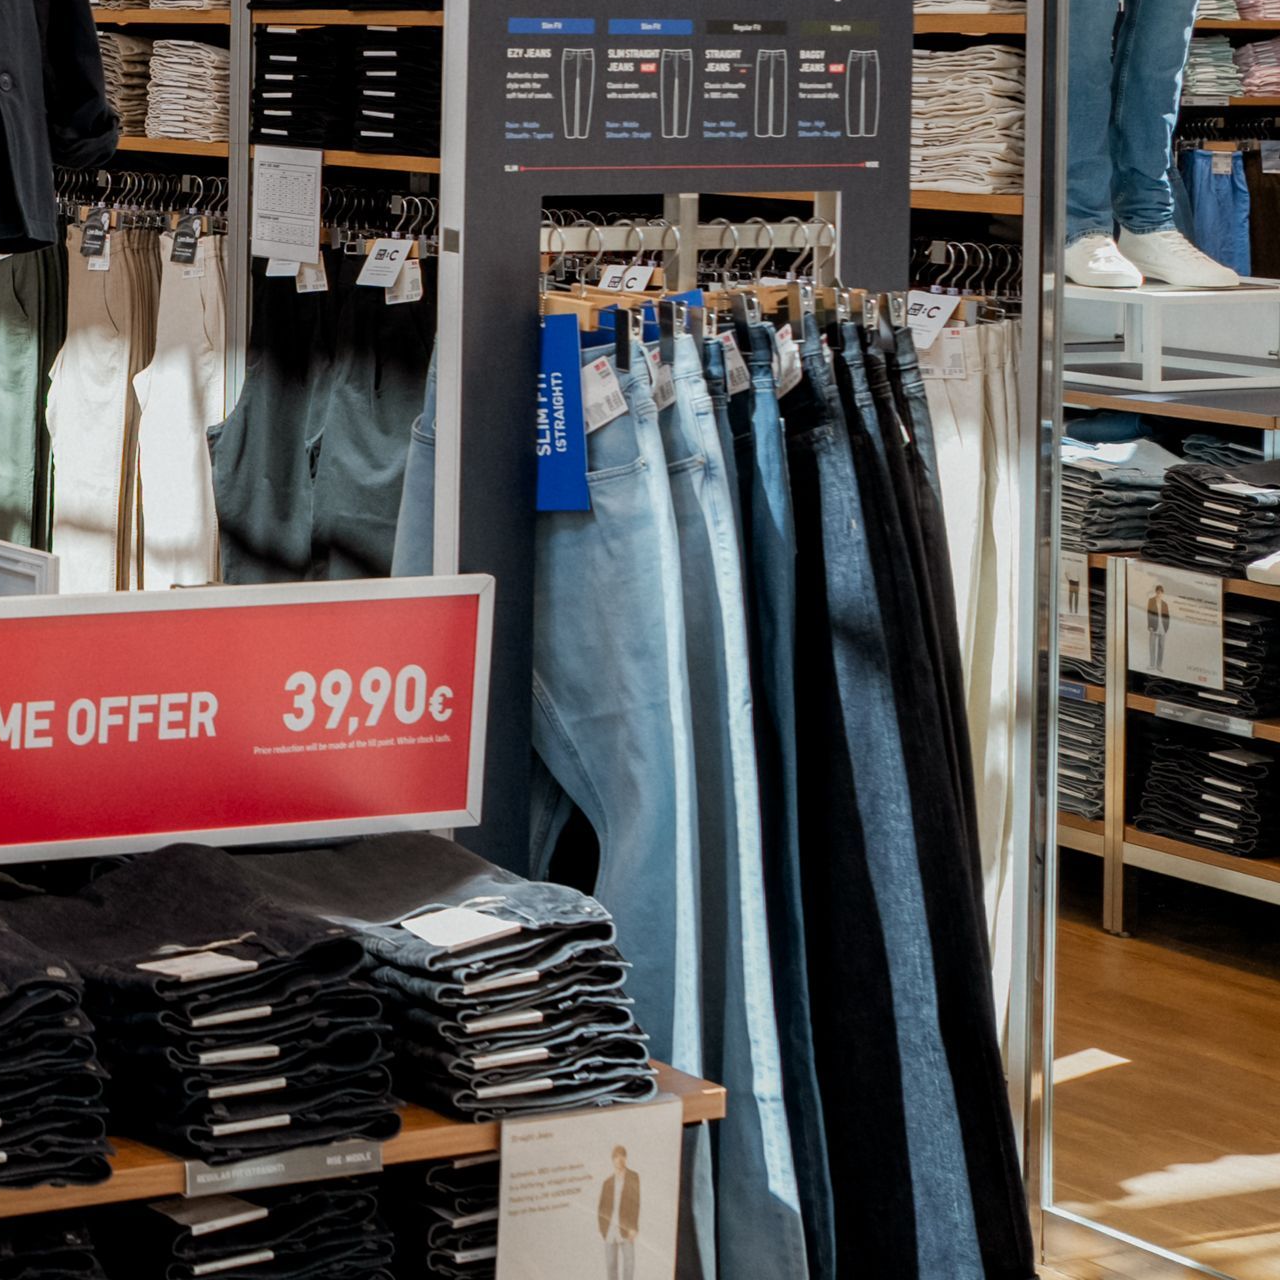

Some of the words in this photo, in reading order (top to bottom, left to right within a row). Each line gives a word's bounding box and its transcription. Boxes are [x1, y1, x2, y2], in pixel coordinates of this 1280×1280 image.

[507, 49, 523, 58] EZY
[523, 49, 552, 58] JEANS
[705, 50, 742, 60] STRAIGHT
[799, 50, 826, 60] BAGGY
[607, 63, 634, 72] JEANS
[705, 63, 730, 72] JEANS
[799, 64, 825, 73] JEANS
[536, 408, 552, 456] SLIM
[65, 689, 219, 749] OFFER
[253, 745, 272, 755] Price
[273, 744, 305, 753] reduction
[328, 741, 347, 750] made
[356, 739, 367, 748] the
